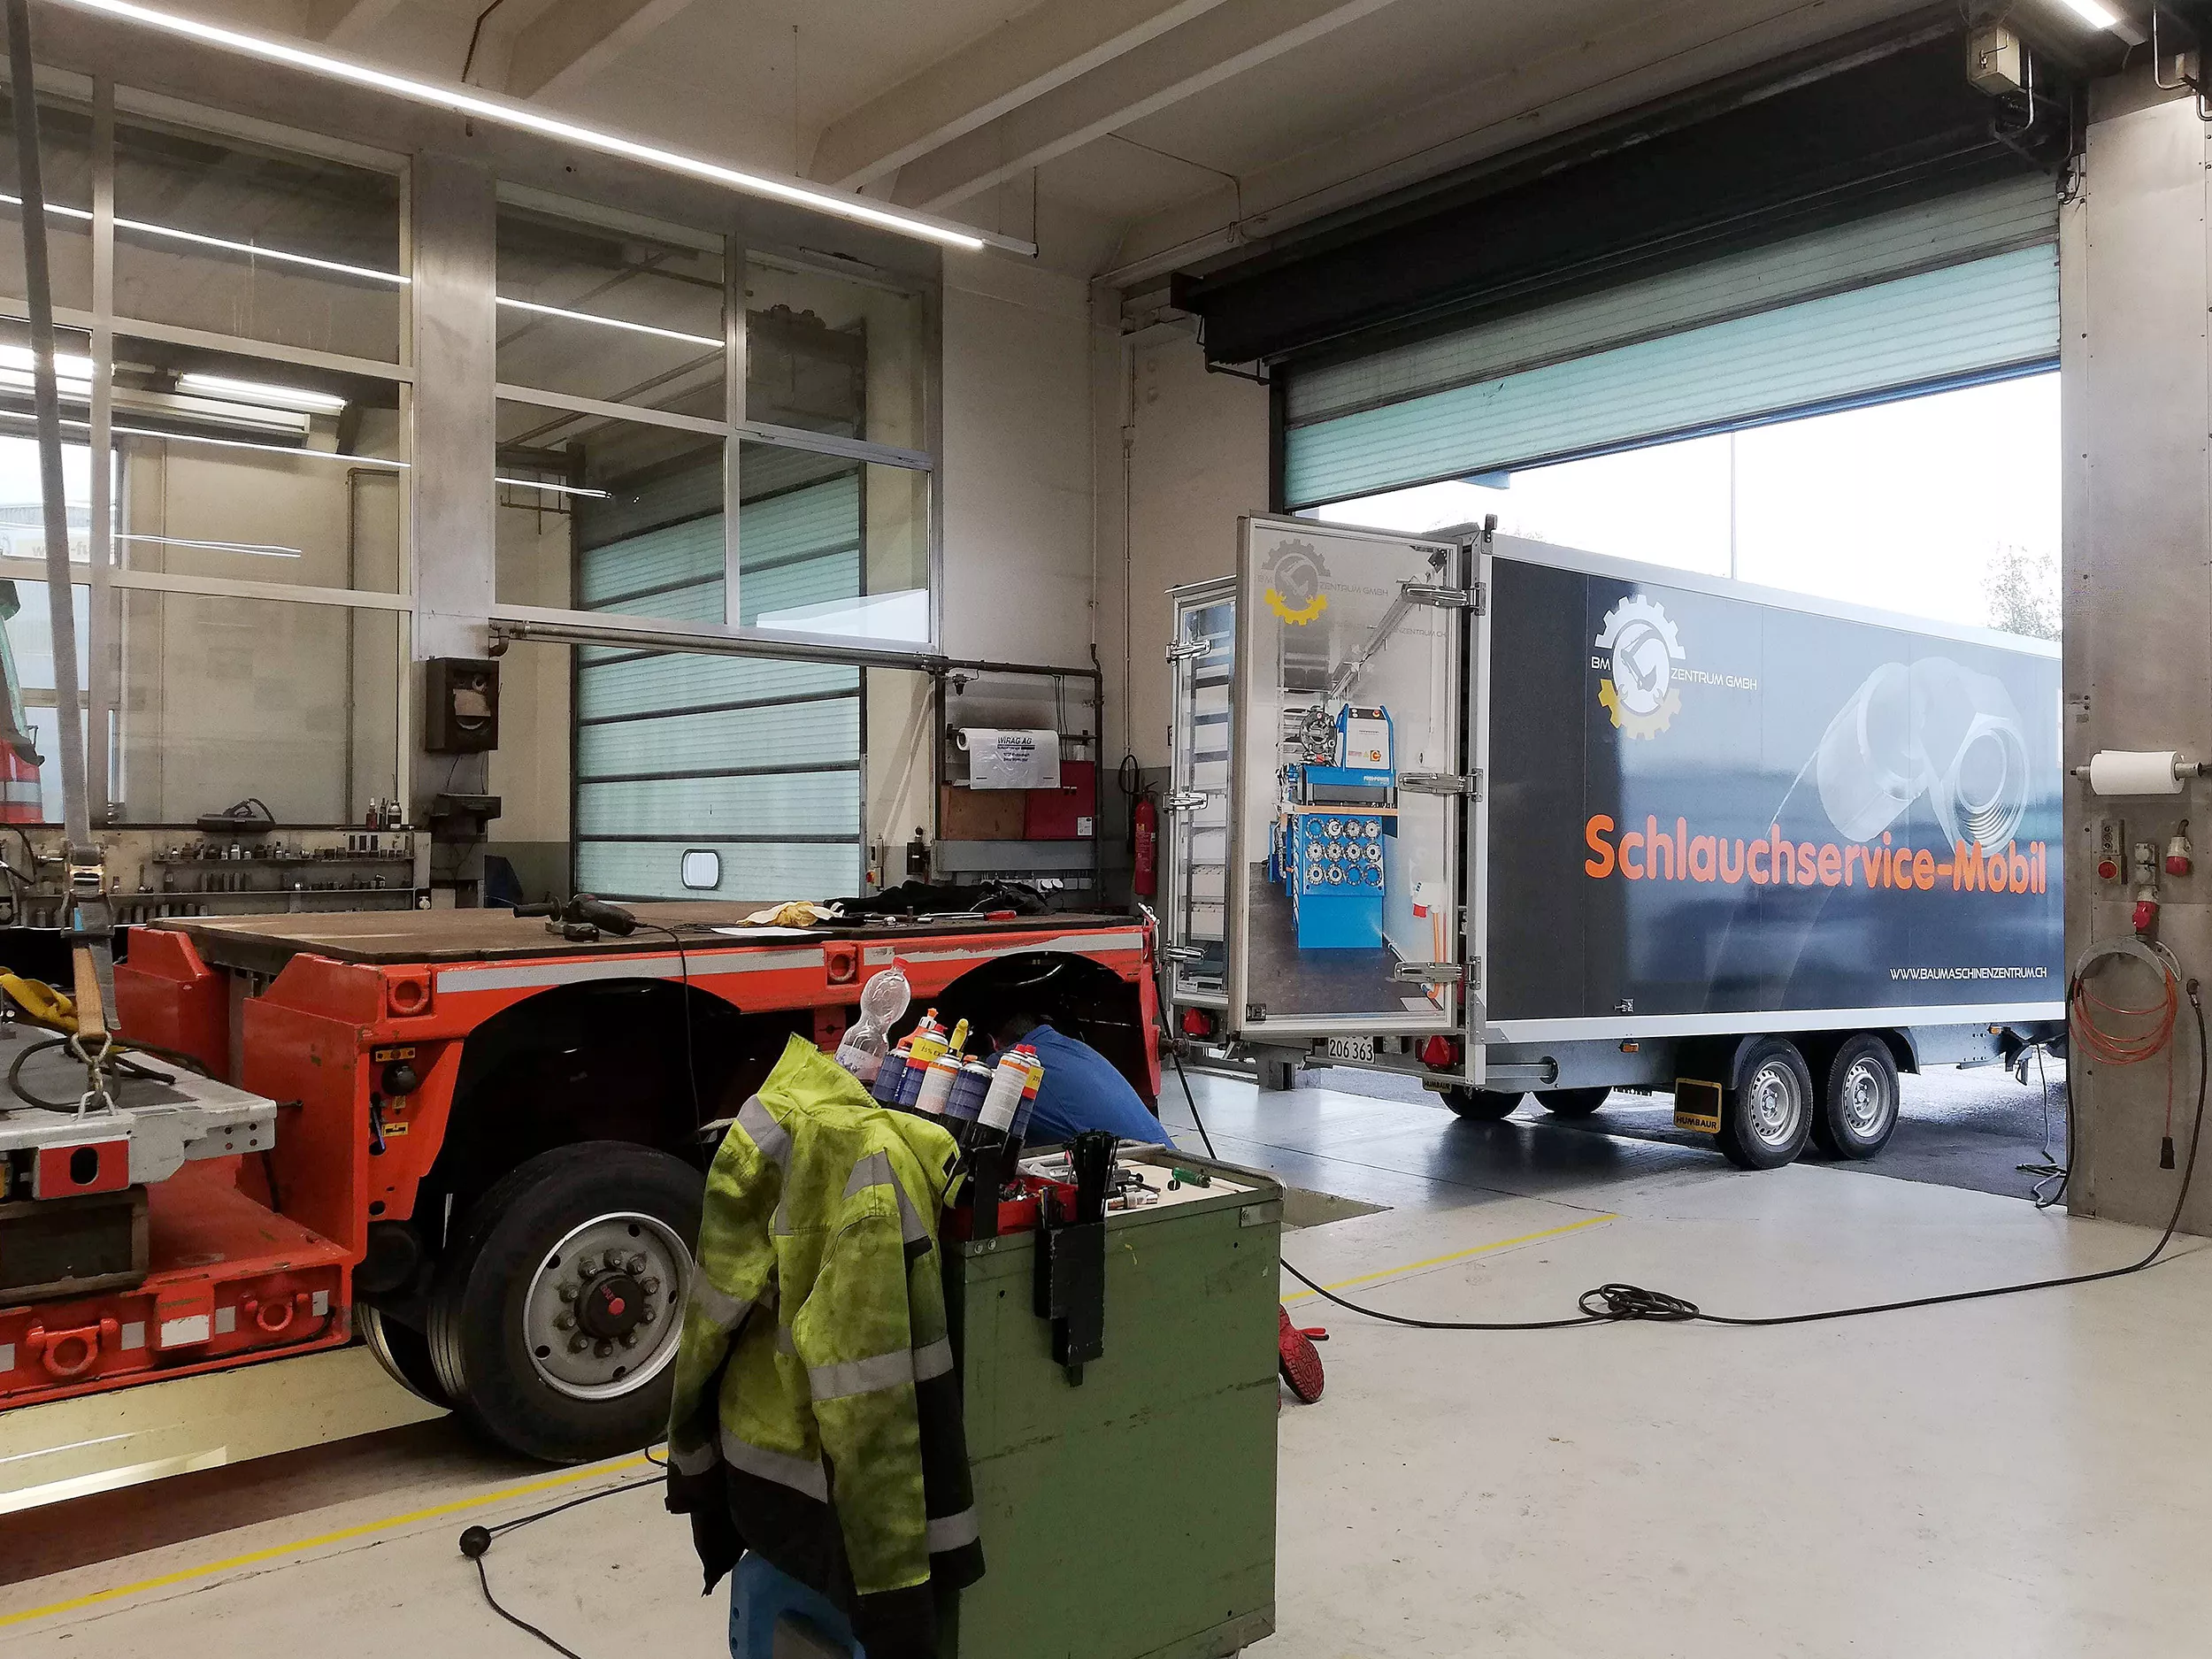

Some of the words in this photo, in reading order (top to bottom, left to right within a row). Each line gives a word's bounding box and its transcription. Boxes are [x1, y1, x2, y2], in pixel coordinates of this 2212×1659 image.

[1319, 582, 1362, 595] ZENTRUM
[1363, 588, 1389, 596] GMBH
[1592, 656, 1610, 671] BM
[1671, 667, 1724, 686] ZENTRUM
[1725, 675, 1757, 690] GMBH
[1585, 814, 2046, 894] Schlauchservice-Mobil
[1889, 966, 2047, 980] WWW.BAUMASCHINENZENTRUM.CH
[1329, 1039, 1349, 1058] 206
[1352, 1042, 1372, 1061] 363
[1424, 1080, 1452, 1090] HUMBAUR
[1676, 1115, 1717, 1130] HUMBAUR
